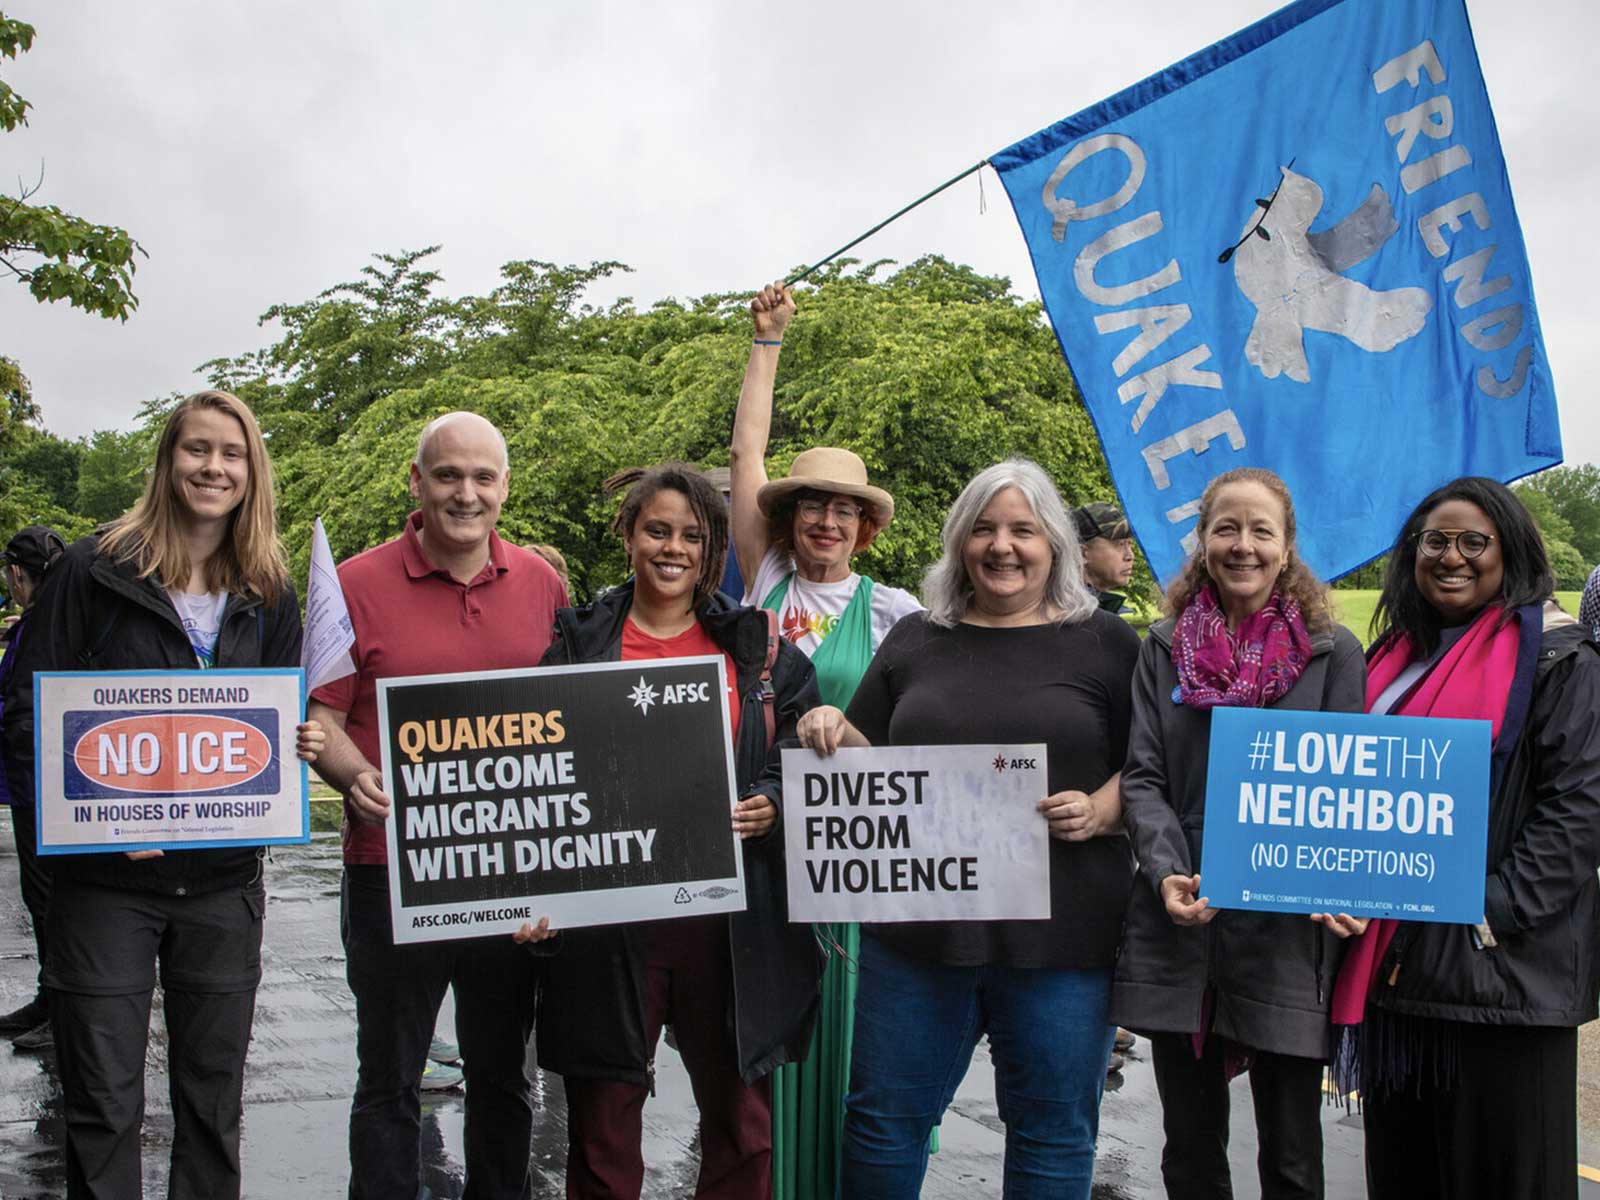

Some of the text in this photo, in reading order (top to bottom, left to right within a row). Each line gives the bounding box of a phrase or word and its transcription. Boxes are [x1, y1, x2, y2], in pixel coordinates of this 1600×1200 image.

[1372, 40, 1533, 399] FRIENDS
[93, 687, 249, 705] QUAKERS DEMAND
[662, 682, 710, 705] AFSC
[98, 731, 248, 776] NO ICE
[398, 710, 566, 763] QUAKERS
[400, 751, 576, 798] WELCOME
[1010, 758, 1036, 770] AFSC
[804, 770, 929, 807] DIVEST
[74, 801, 271, 823] IN HOUSES OF WORSHIP
[405, 792, 591, 840] MIGRANTS
[1237, 782, 1454, 836] NEIGHBOR
[805, 815, 911, 850] FROM
[407, 828, 657, 883] WITH DIGNITY
[1251, 842, 1436, 883] (NO EXCEPTIONS)
[805, 857, 979, 893] VIOLENCE
[412, 907, 531, 928] AFSC.ORG/WELCOME
[1250, 893, 1276, 903] FRIENDS
[1276, 895, 1312, 905] COMMITTEE
[1313, 897, 1323, 905] ON
[1324, 897, 1353, 908] NATIONAL
[1354, 899, 1393, 910] LEGISLATION
